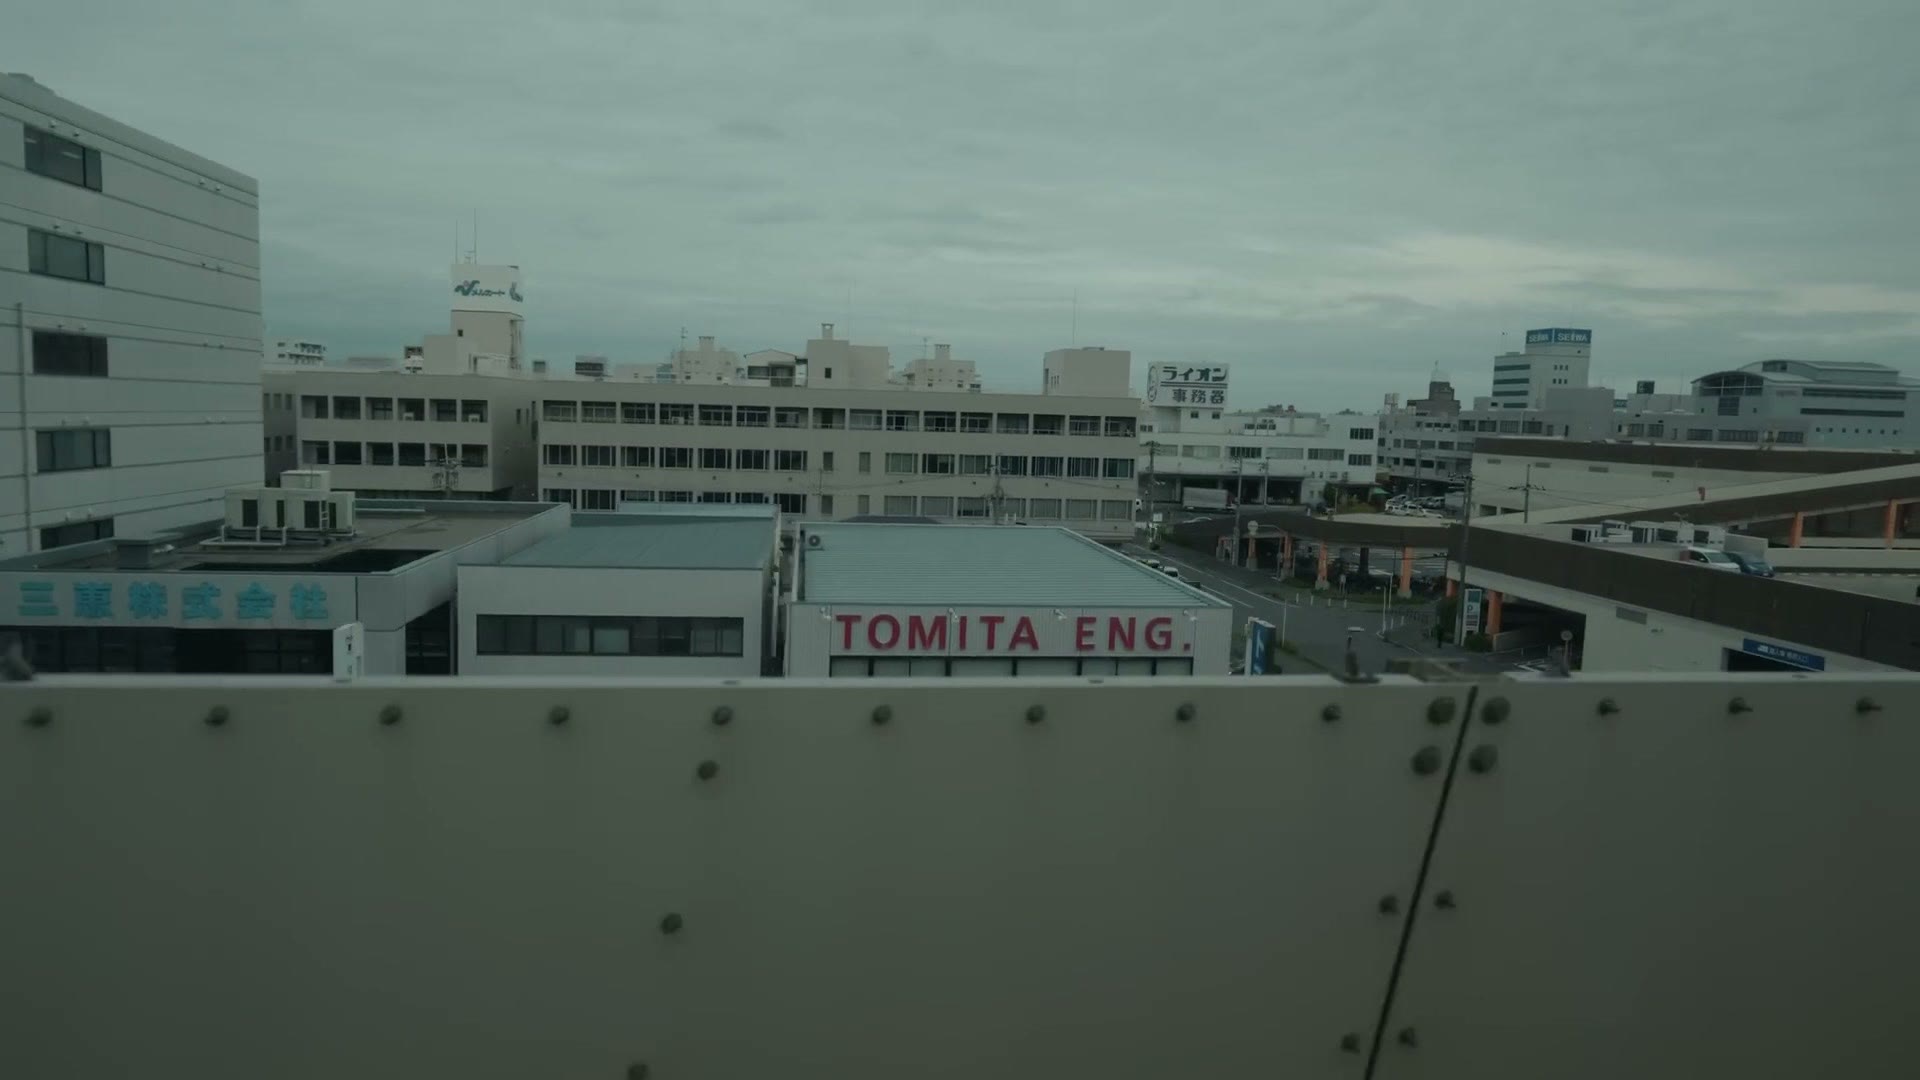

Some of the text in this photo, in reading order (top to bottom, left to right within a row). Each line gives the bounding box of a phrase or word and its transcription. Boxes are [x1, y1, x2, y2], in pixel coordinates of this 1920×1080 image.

[1162, 366, 1227, 382] ライオン
[1172, 388, 1225, 404] 事務器
[836, 614, 1192, 651] TOMITA ENG.
